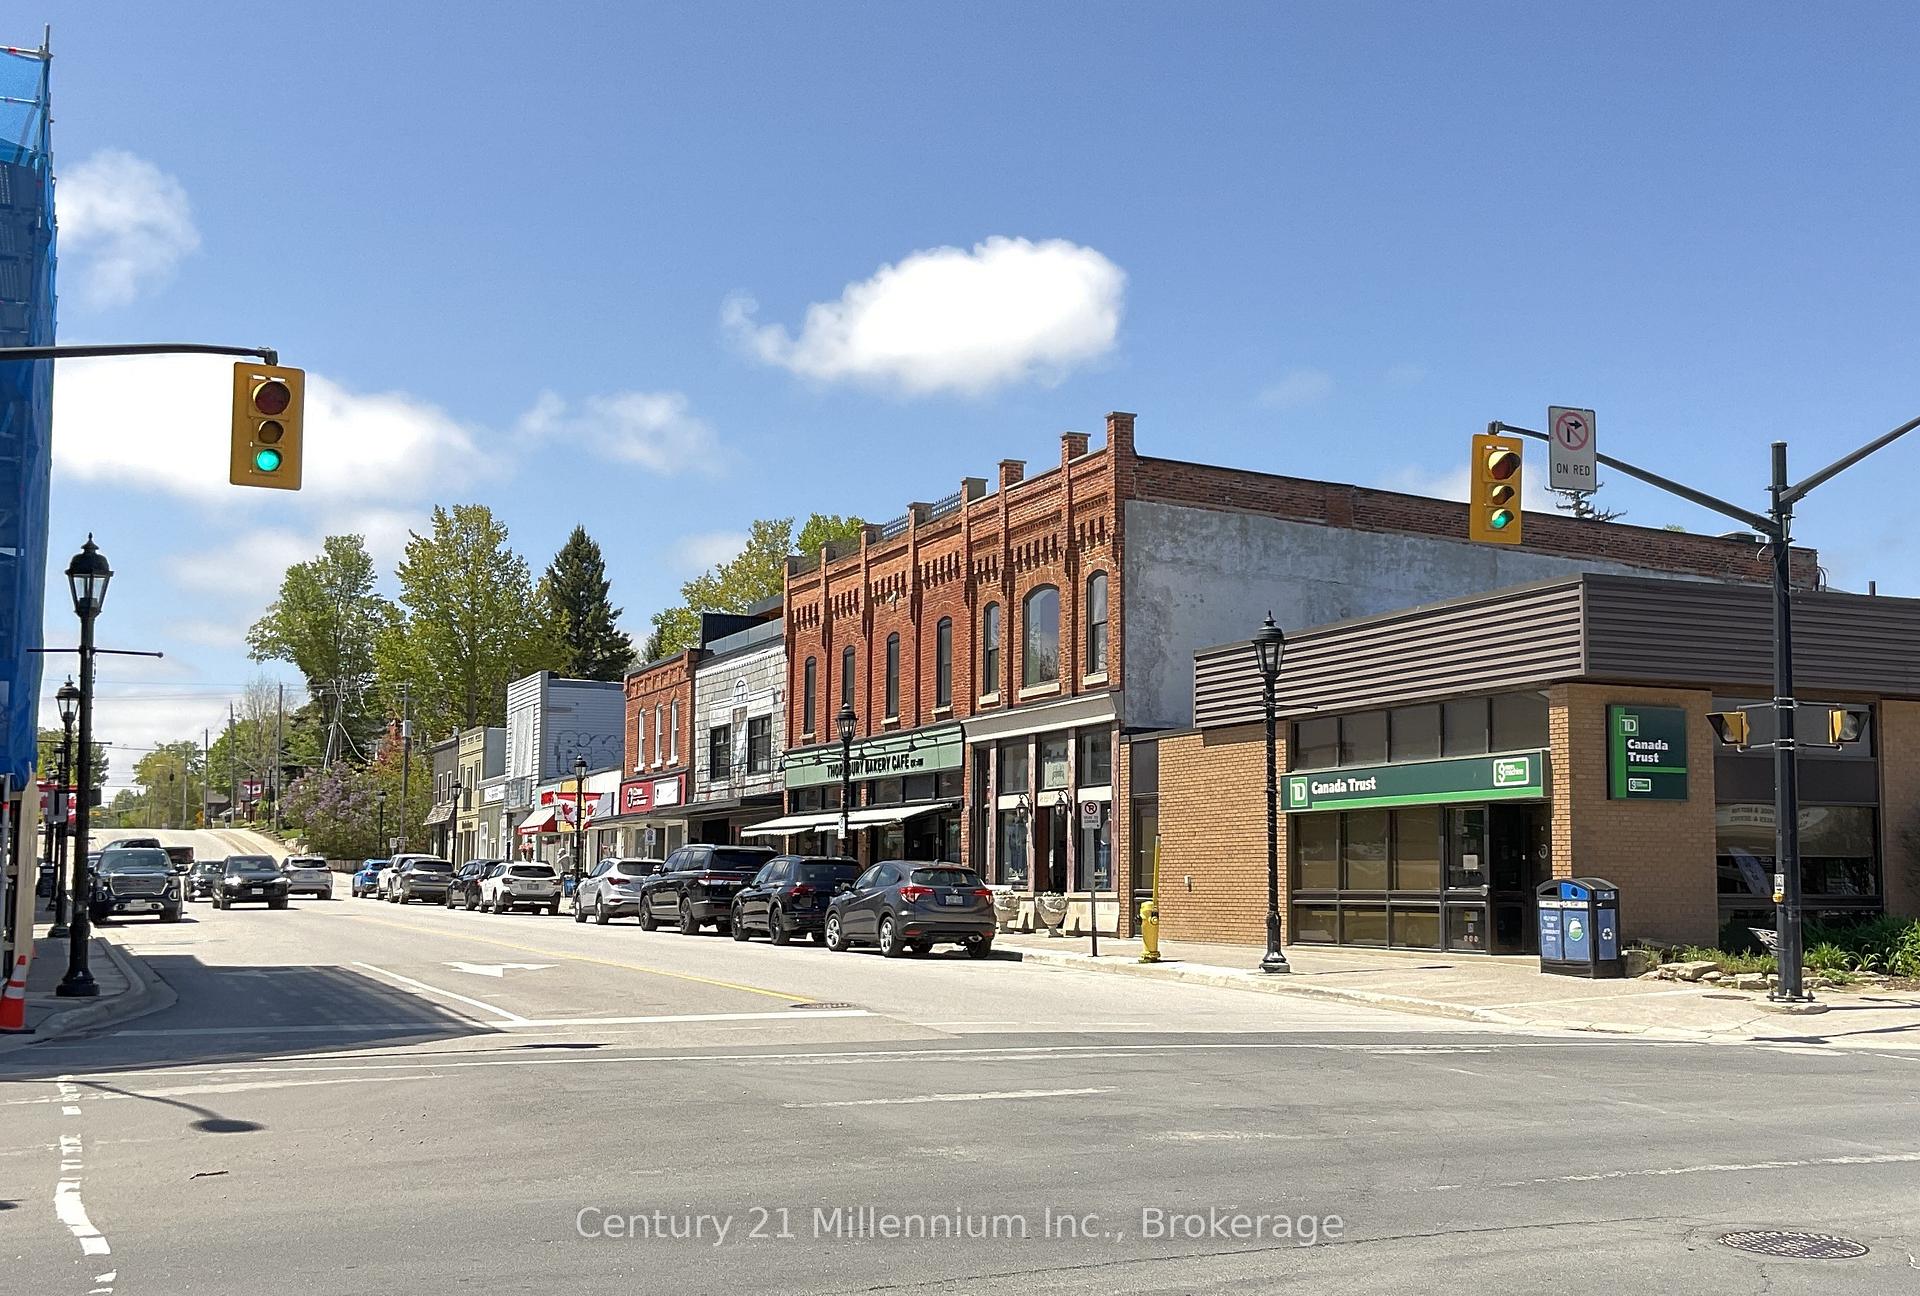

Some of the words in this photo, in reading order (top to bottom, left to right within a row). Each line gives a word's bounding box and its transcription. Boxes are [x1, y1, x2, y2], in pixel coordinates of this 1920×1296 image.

[1556, 463, 1569, 474] ON
[1573, 464, 1591, 476] RED
[1622, 719, 1637, 732] TD
[1627, 739, 1669, 751] Canada
[865, 756, 891, 774] BAKERY
[892, 754, 910, 771] CAFE
[1628, 752, 1660, 763] Trust
[1292, 783, 1306, 800] TD
[1311, 779, 1347, 795] Canada
[1348, 776, 1376, 792] Trust
